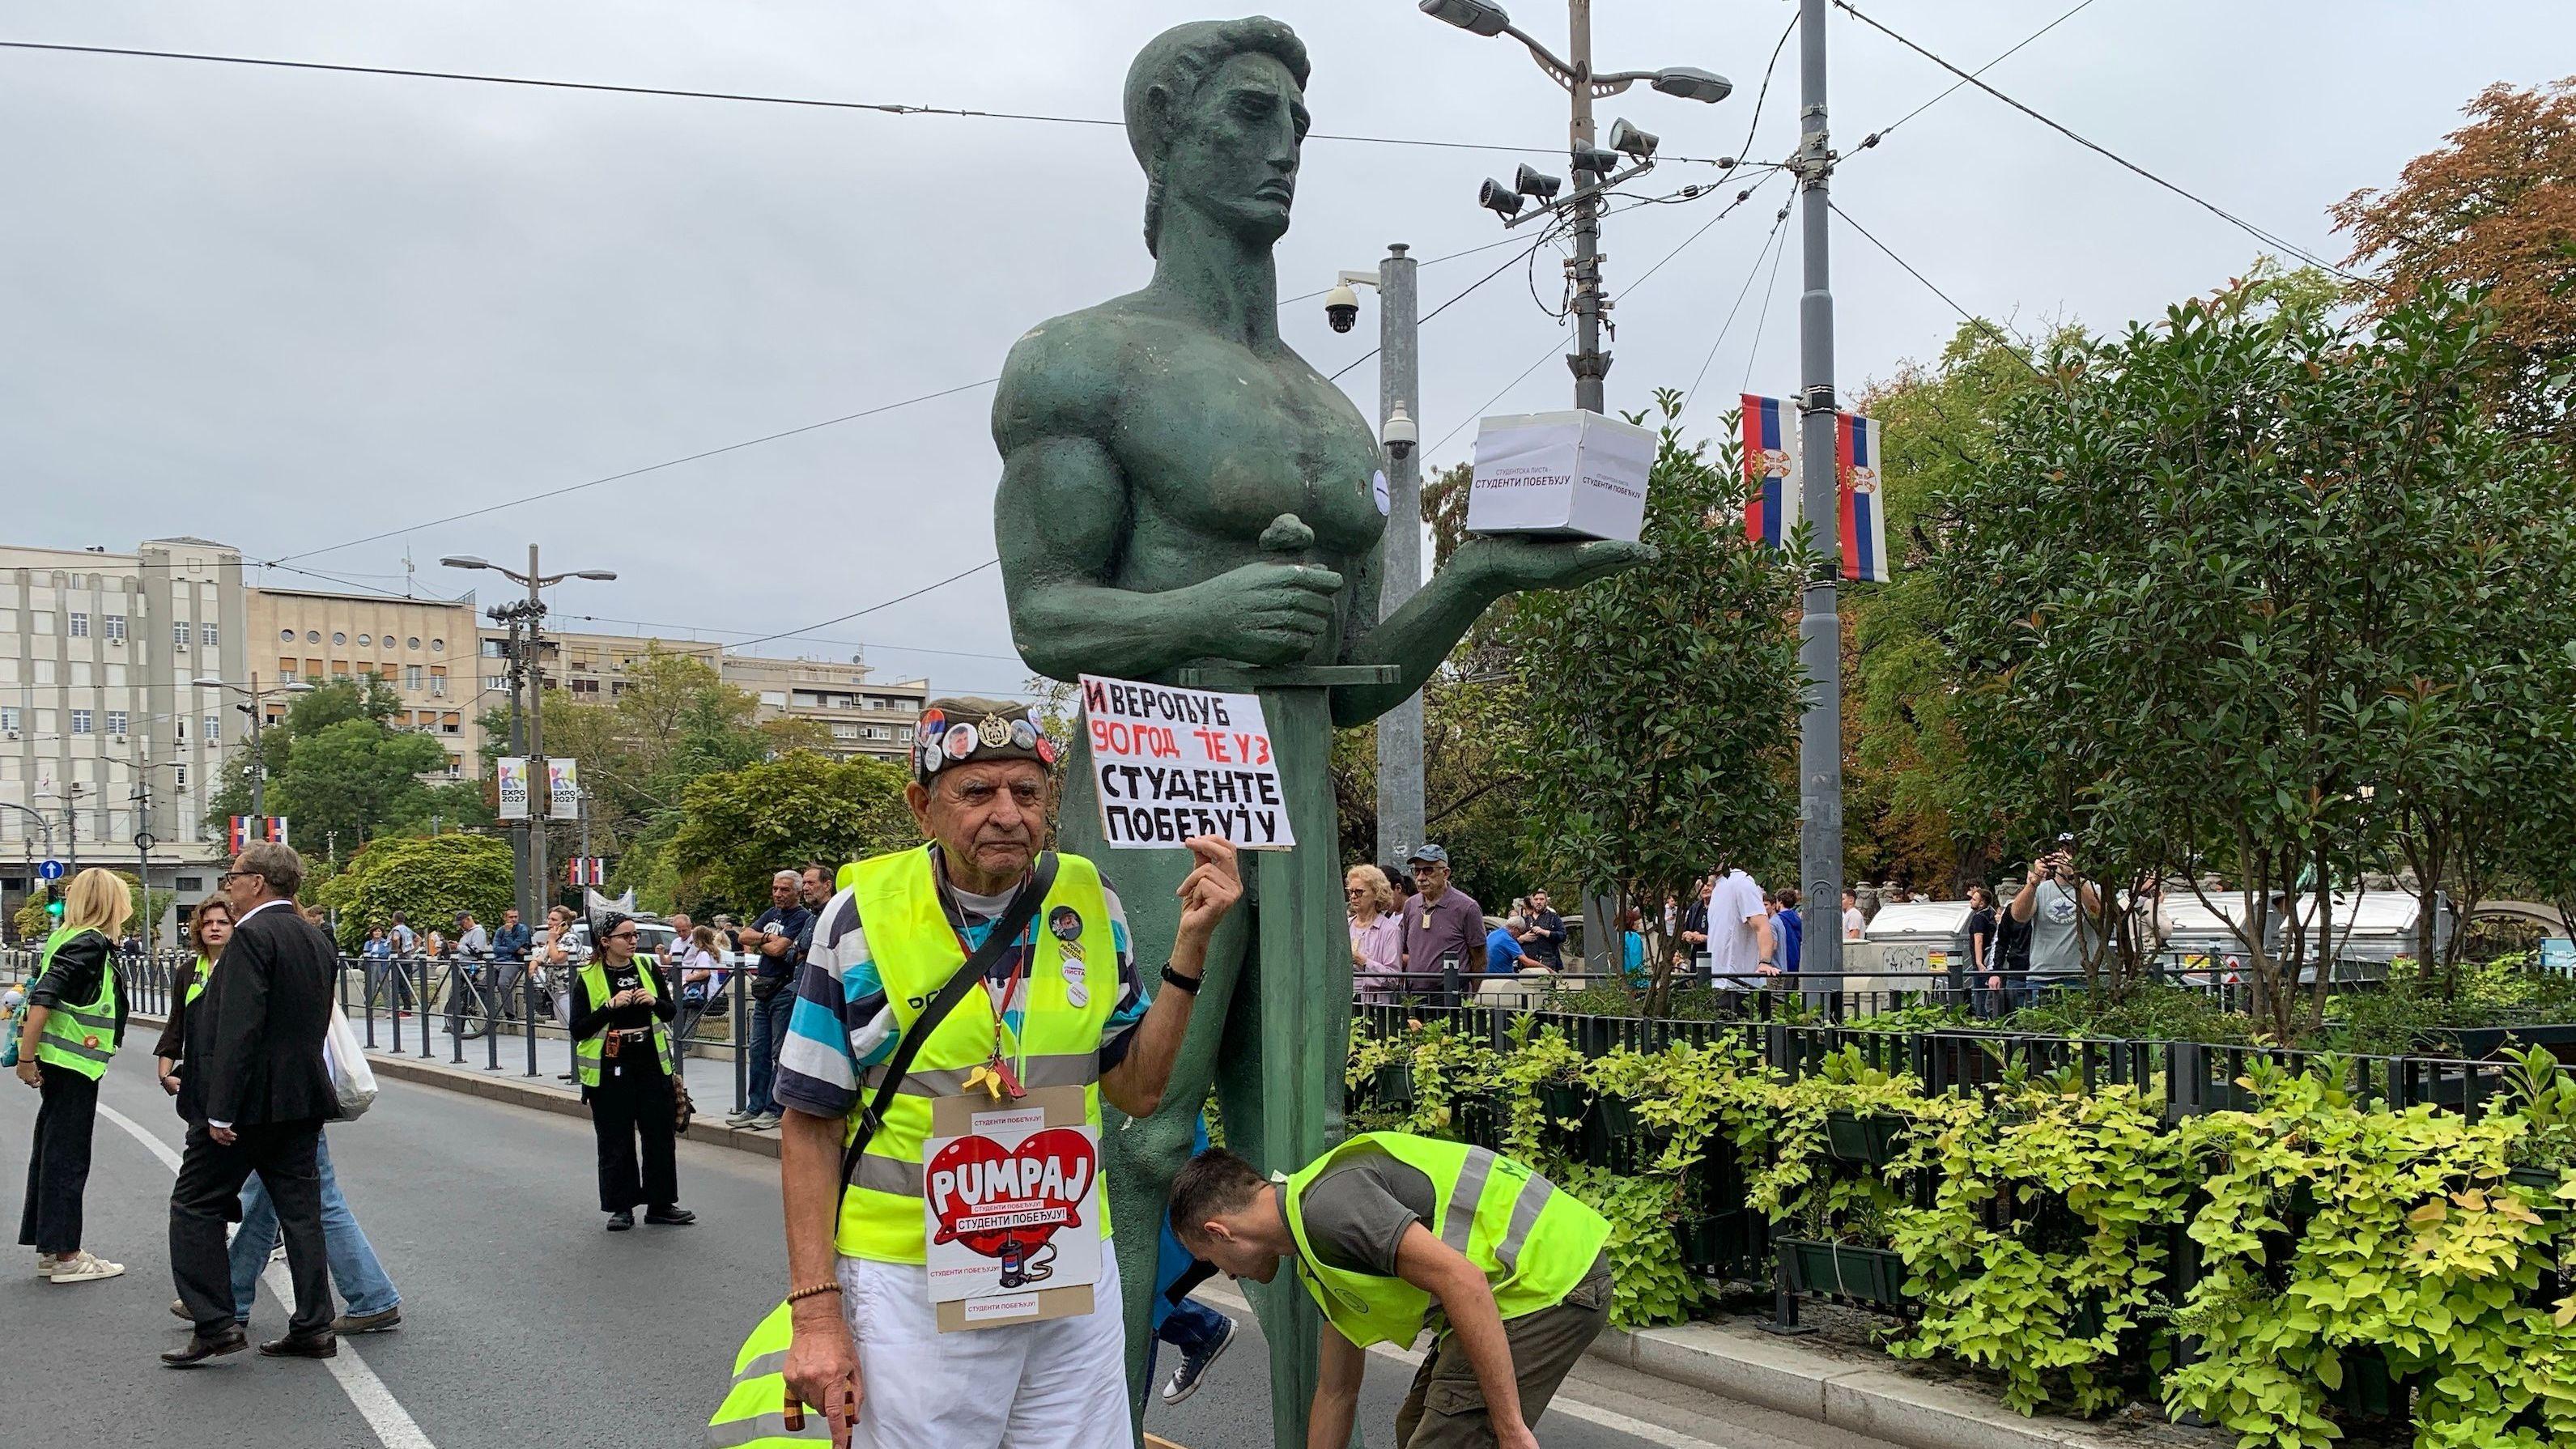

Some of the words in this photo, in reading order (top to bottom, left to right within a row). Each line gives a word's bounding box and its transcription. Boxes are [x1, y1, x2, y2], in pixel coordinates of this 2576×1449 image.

[1475, 478, 1521, 489] СТУДЕНТИ
[1523, 475, 1571, 487] ПОБЕЂУЈУ
[1583, 476, 1613, 491] СТУДЕНТИ
[1613, 485, 1642, 499] ПОБЕЂУЈУ
[1101, 764, 1279, 805] СТУДЕНТЕ
[1106, 802, 1275, 843] ПОБЕЂУЈУ
[974, 1119, 1006, 1127] СТУДЕНТИ
[1006, 1115, 1042, 1124] ПОБЕЂУЈУ!
[932, 1155, 1088, 1216] PUMPAJ
[974, 1205, 1006, 1213] СТУДЕНТИ
[1007, 1200, 1042, 1209] ПОБЕЂУЈУ!
[958, 1215, 1010, 1230] СТУДЕНТИ
[1012, 1209, 1065, 1225] ПОБЕЂУЈУ!
[930, 1269, 963, 1277] СТУДЕНТИ
[967, 1303, 1001, 1312] СТУДЕНТИ
[1001, 1301, 1036, 1310] ПОБЕЂУЈУ!
